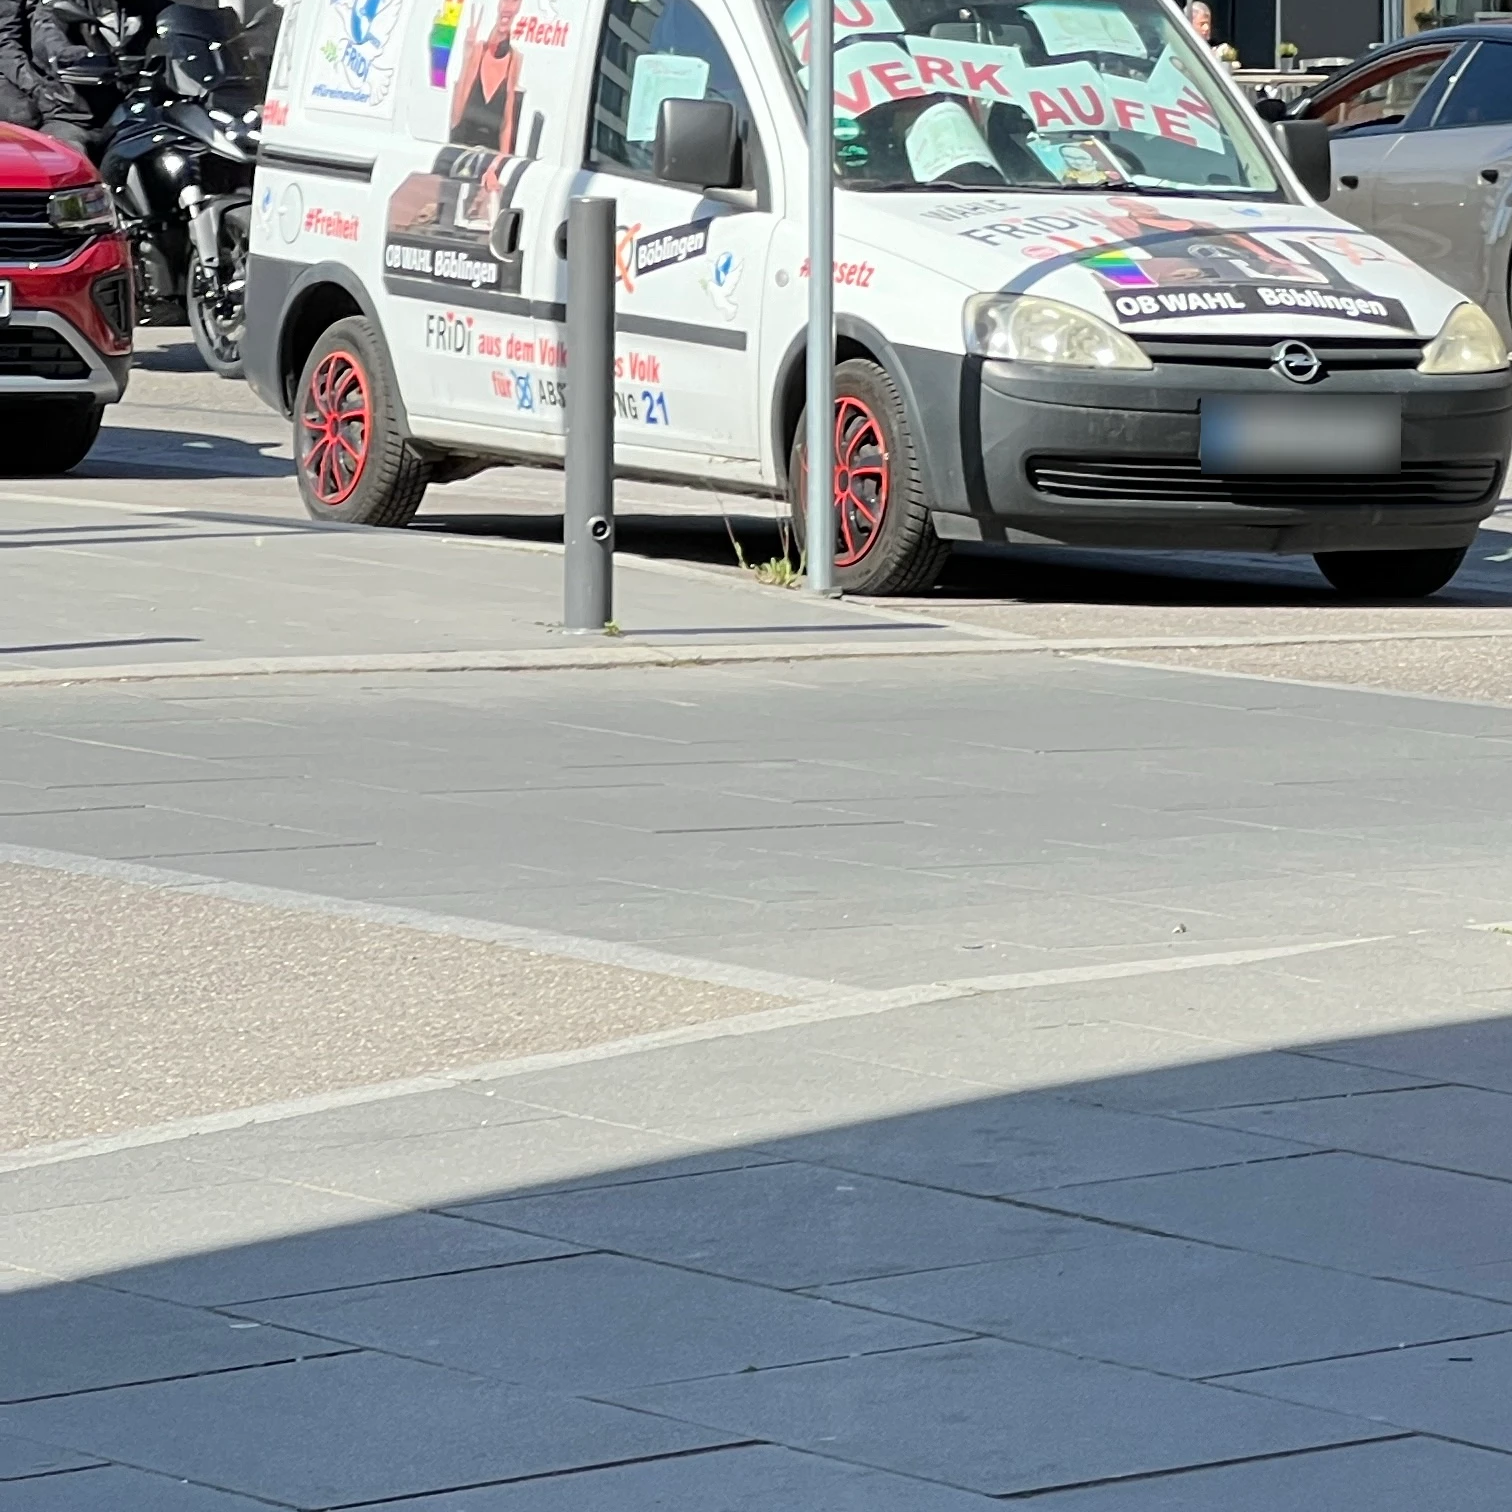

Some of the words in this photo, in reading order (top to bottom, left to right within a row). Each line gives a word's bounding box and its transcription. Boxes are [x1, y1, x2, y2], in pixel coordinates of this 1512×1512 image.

[513, 16, 570, 47] #Recht
[304, 207, 360, 242] #Freiheit
[385, 244, 402, 269] OB
[401, 246, 433, 273] WAHL
[434, 250, 498, 289] Böblingen
[637, 231, 705, 270] Böblingen
[799, 256, 875, 288] #setz
[1115, 295, 1161, 317] OB
[1157, 291, 1247, 314] WAHL
[1256, 287, 1389, 317] Böblingen
[478, 333, 502, 358] aus
[506, 332, 535, 365] dem
[538, 337, 568, 369] Volk
[629, 351, 661, 384] Volk
[491, 370, 512, 399] für
[641, 390, 670, 426] 21
